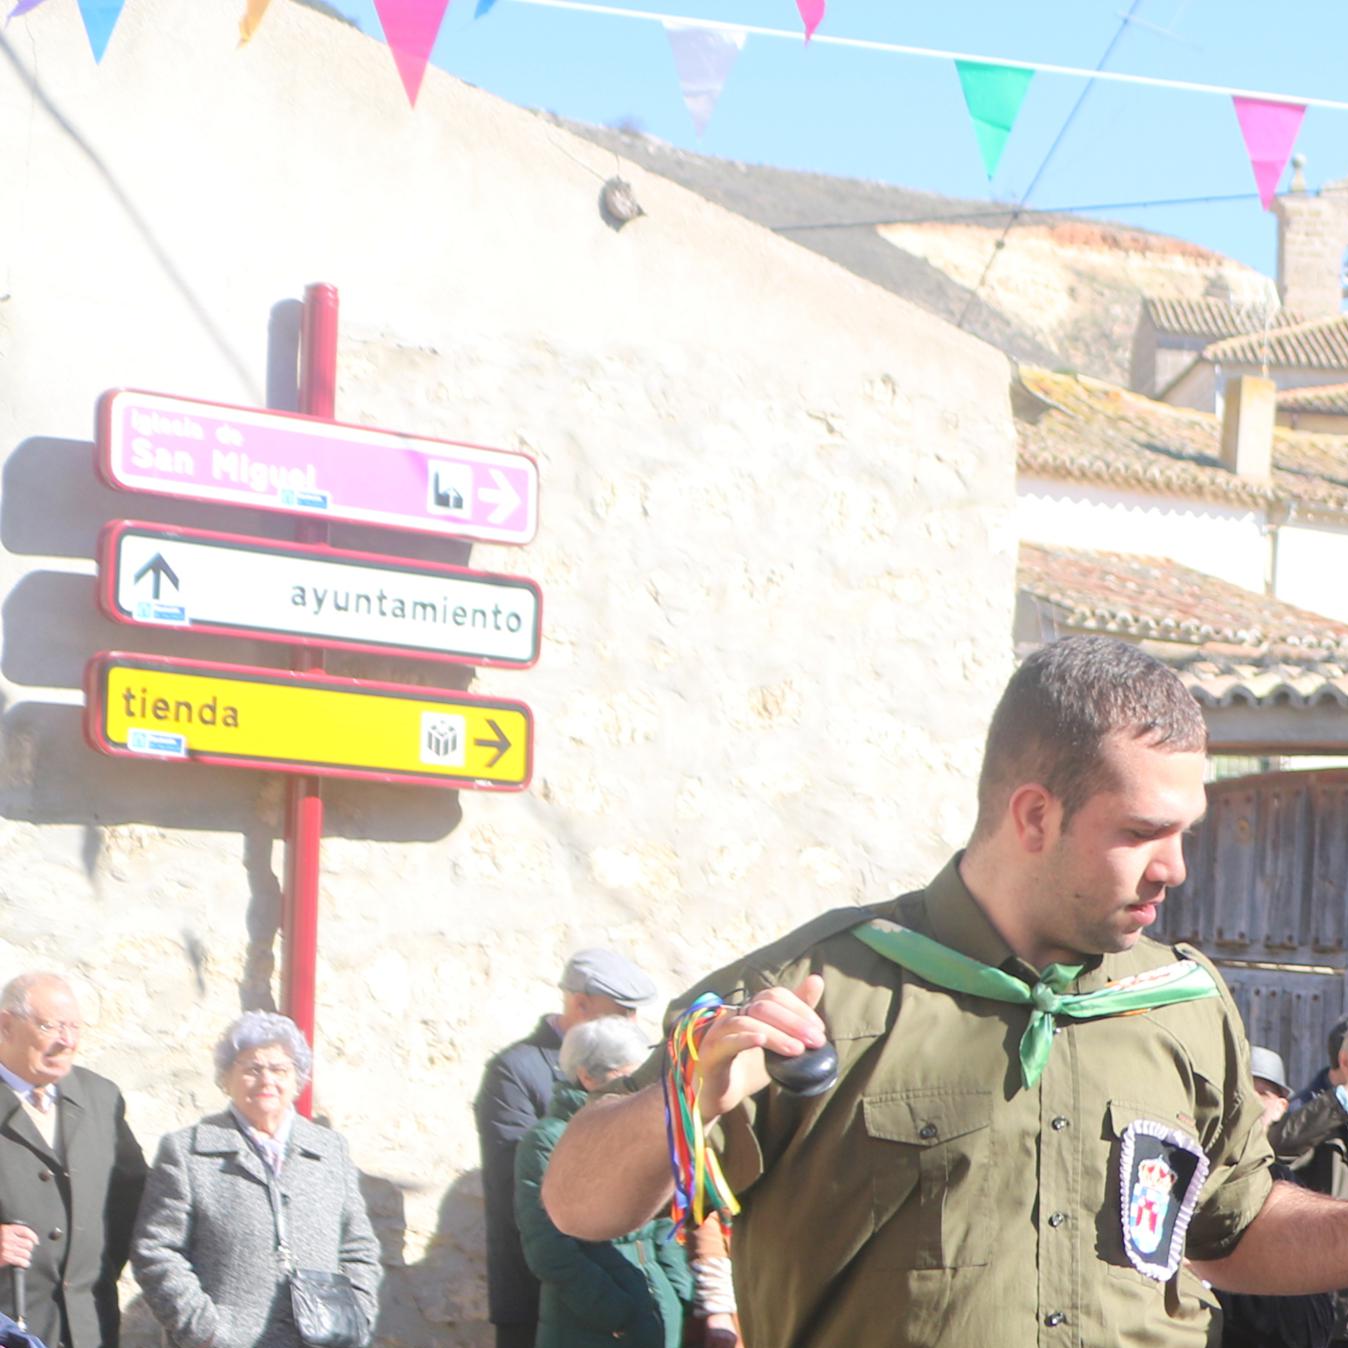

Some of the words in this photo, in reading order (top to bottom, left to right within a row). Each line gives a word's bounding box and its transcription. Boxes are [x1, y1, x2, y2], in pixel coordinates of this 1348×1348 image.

[130, 437, 194, 477] San
[211, 448, 317, 492] Miguel
[290, 581, 524, 634] ayuntamiento
[121, 685, 241, 729] tienda
